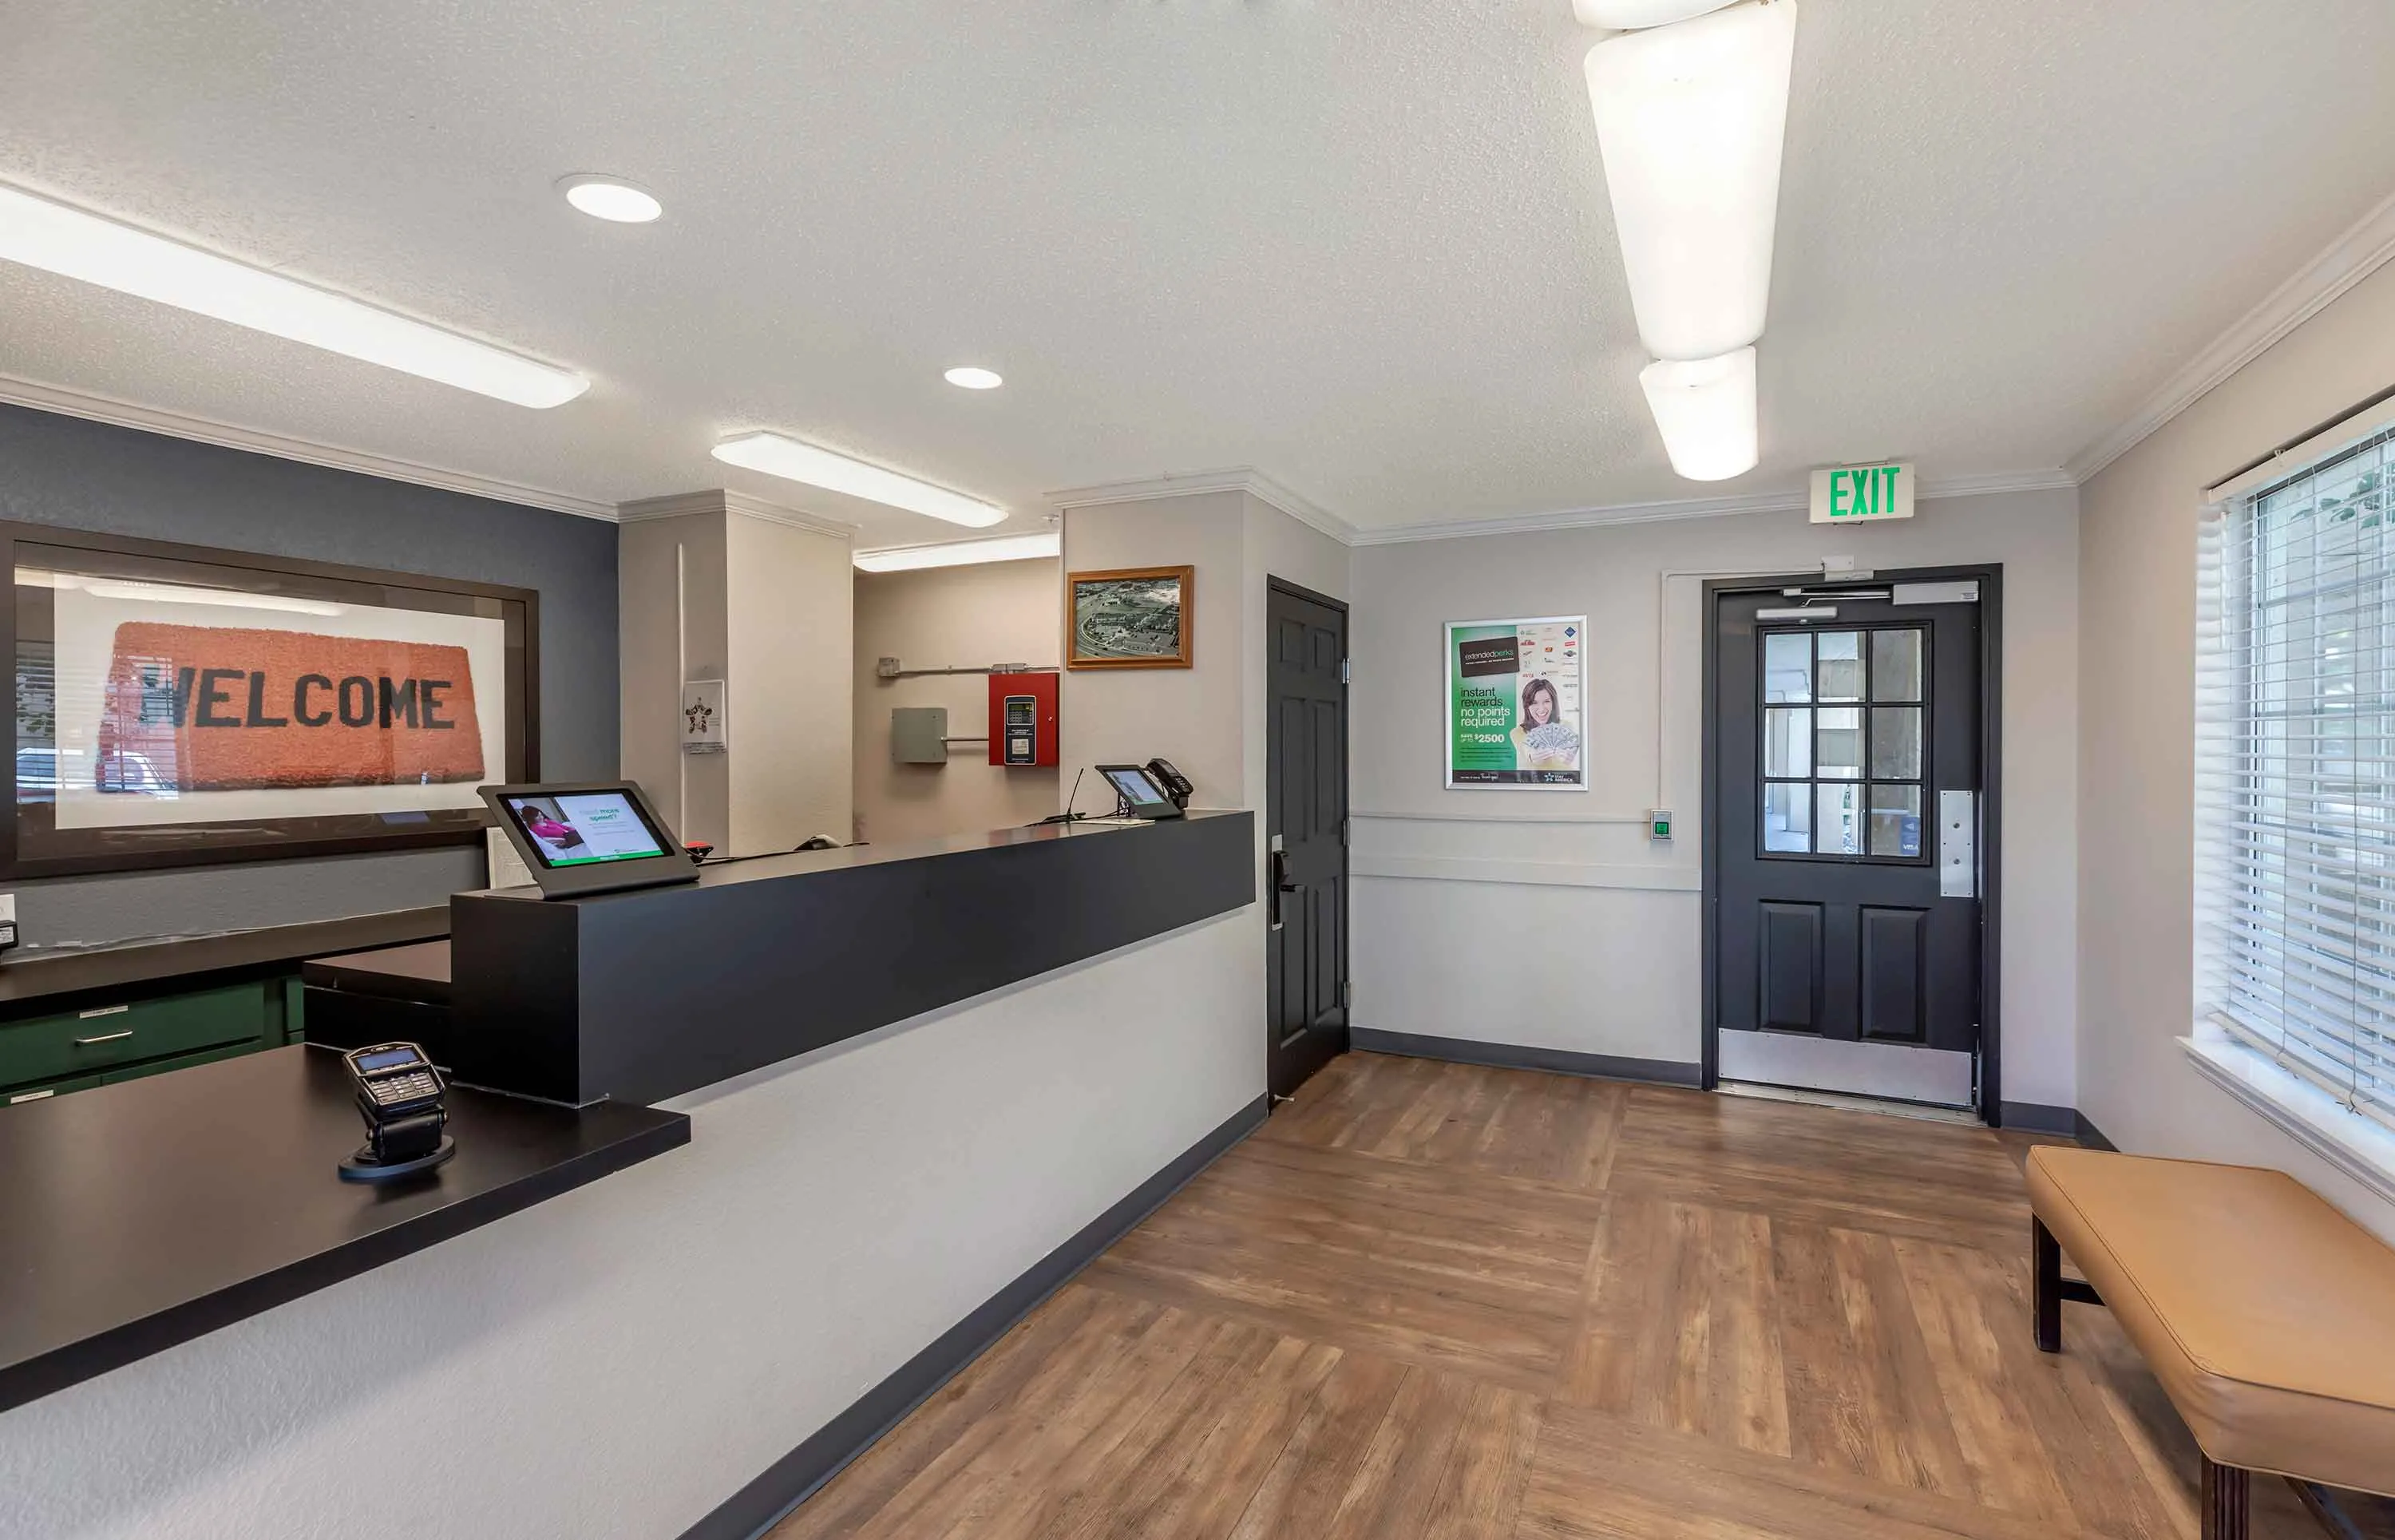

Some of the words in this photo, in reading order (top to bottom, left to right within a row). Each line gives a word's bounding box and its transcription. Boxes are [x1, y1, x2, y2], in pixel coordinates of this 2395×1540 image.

[1830, 467, 1900, 517] EXIT
[1461, 687, 1495, 697] instant
[1461, 697, 1502, 707] rewards
[1461, 708, 1475, 717] no
[1478, 707, 1510, 719] points
[1461, 716, 1505, 728] required
[1474, 733, 1505, 742] $2500
